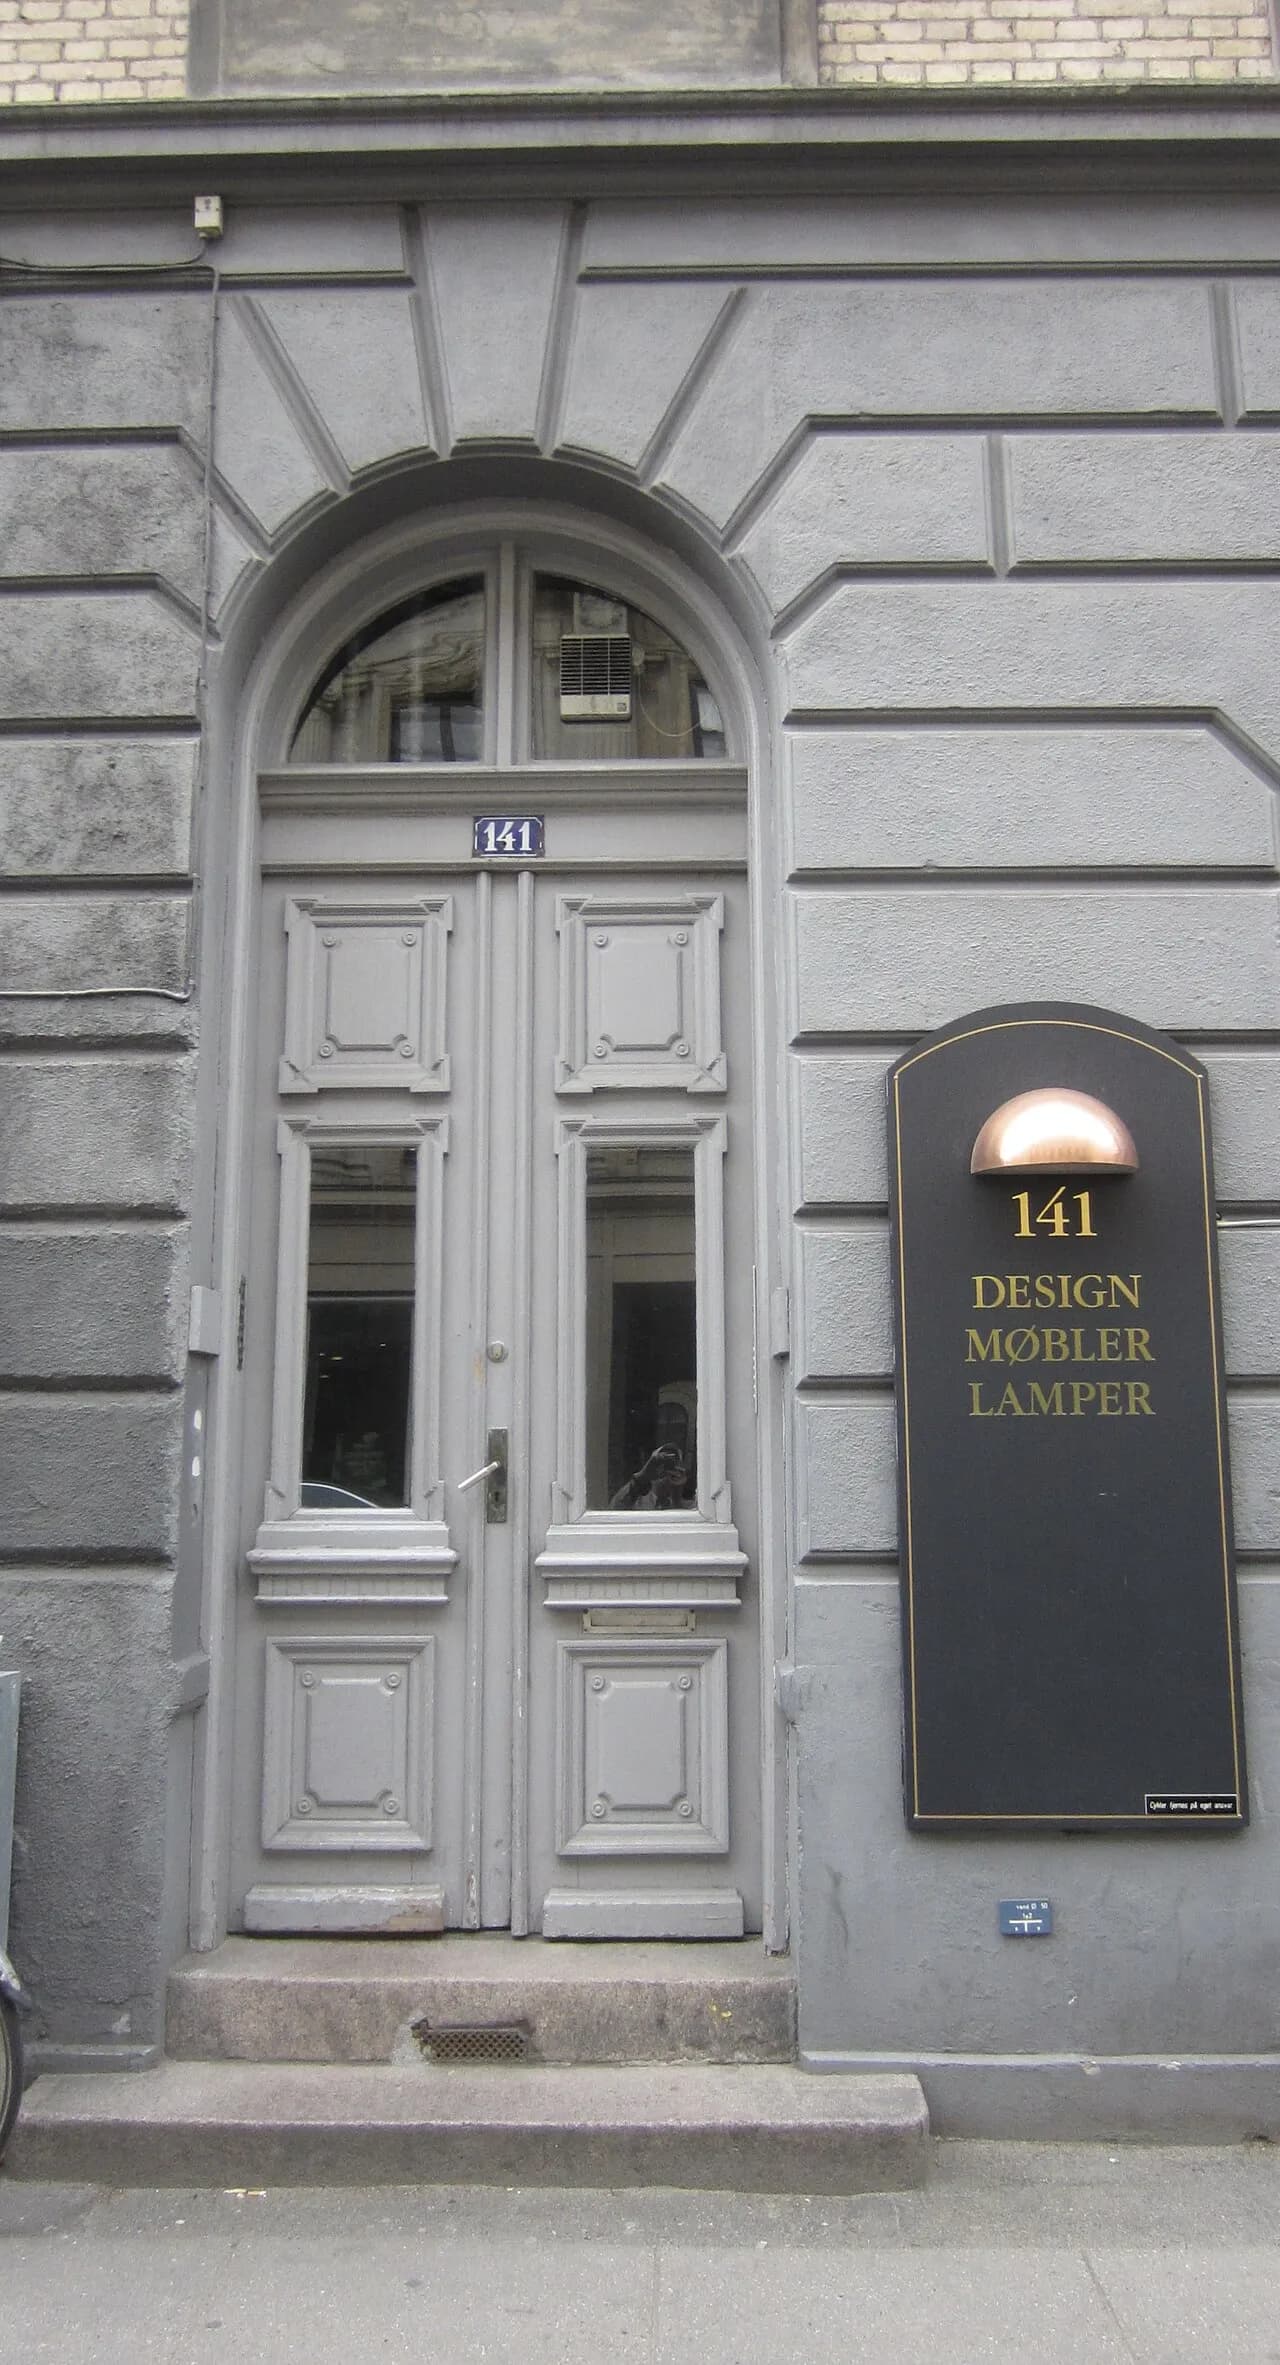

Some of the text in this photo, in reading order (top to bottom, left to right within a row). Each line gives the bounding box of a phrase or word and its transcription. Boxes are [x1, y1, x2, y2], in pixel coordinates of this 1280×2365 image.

[483, 821, 532, 851] 141
[1011, 1185, 1098, 1237] 141
[971, 1274, 1142, 1309] DESIGN
[964, 1324, 1156, 1366] MØBLER
[967, 1382, 1156, 1416] LAMPER
